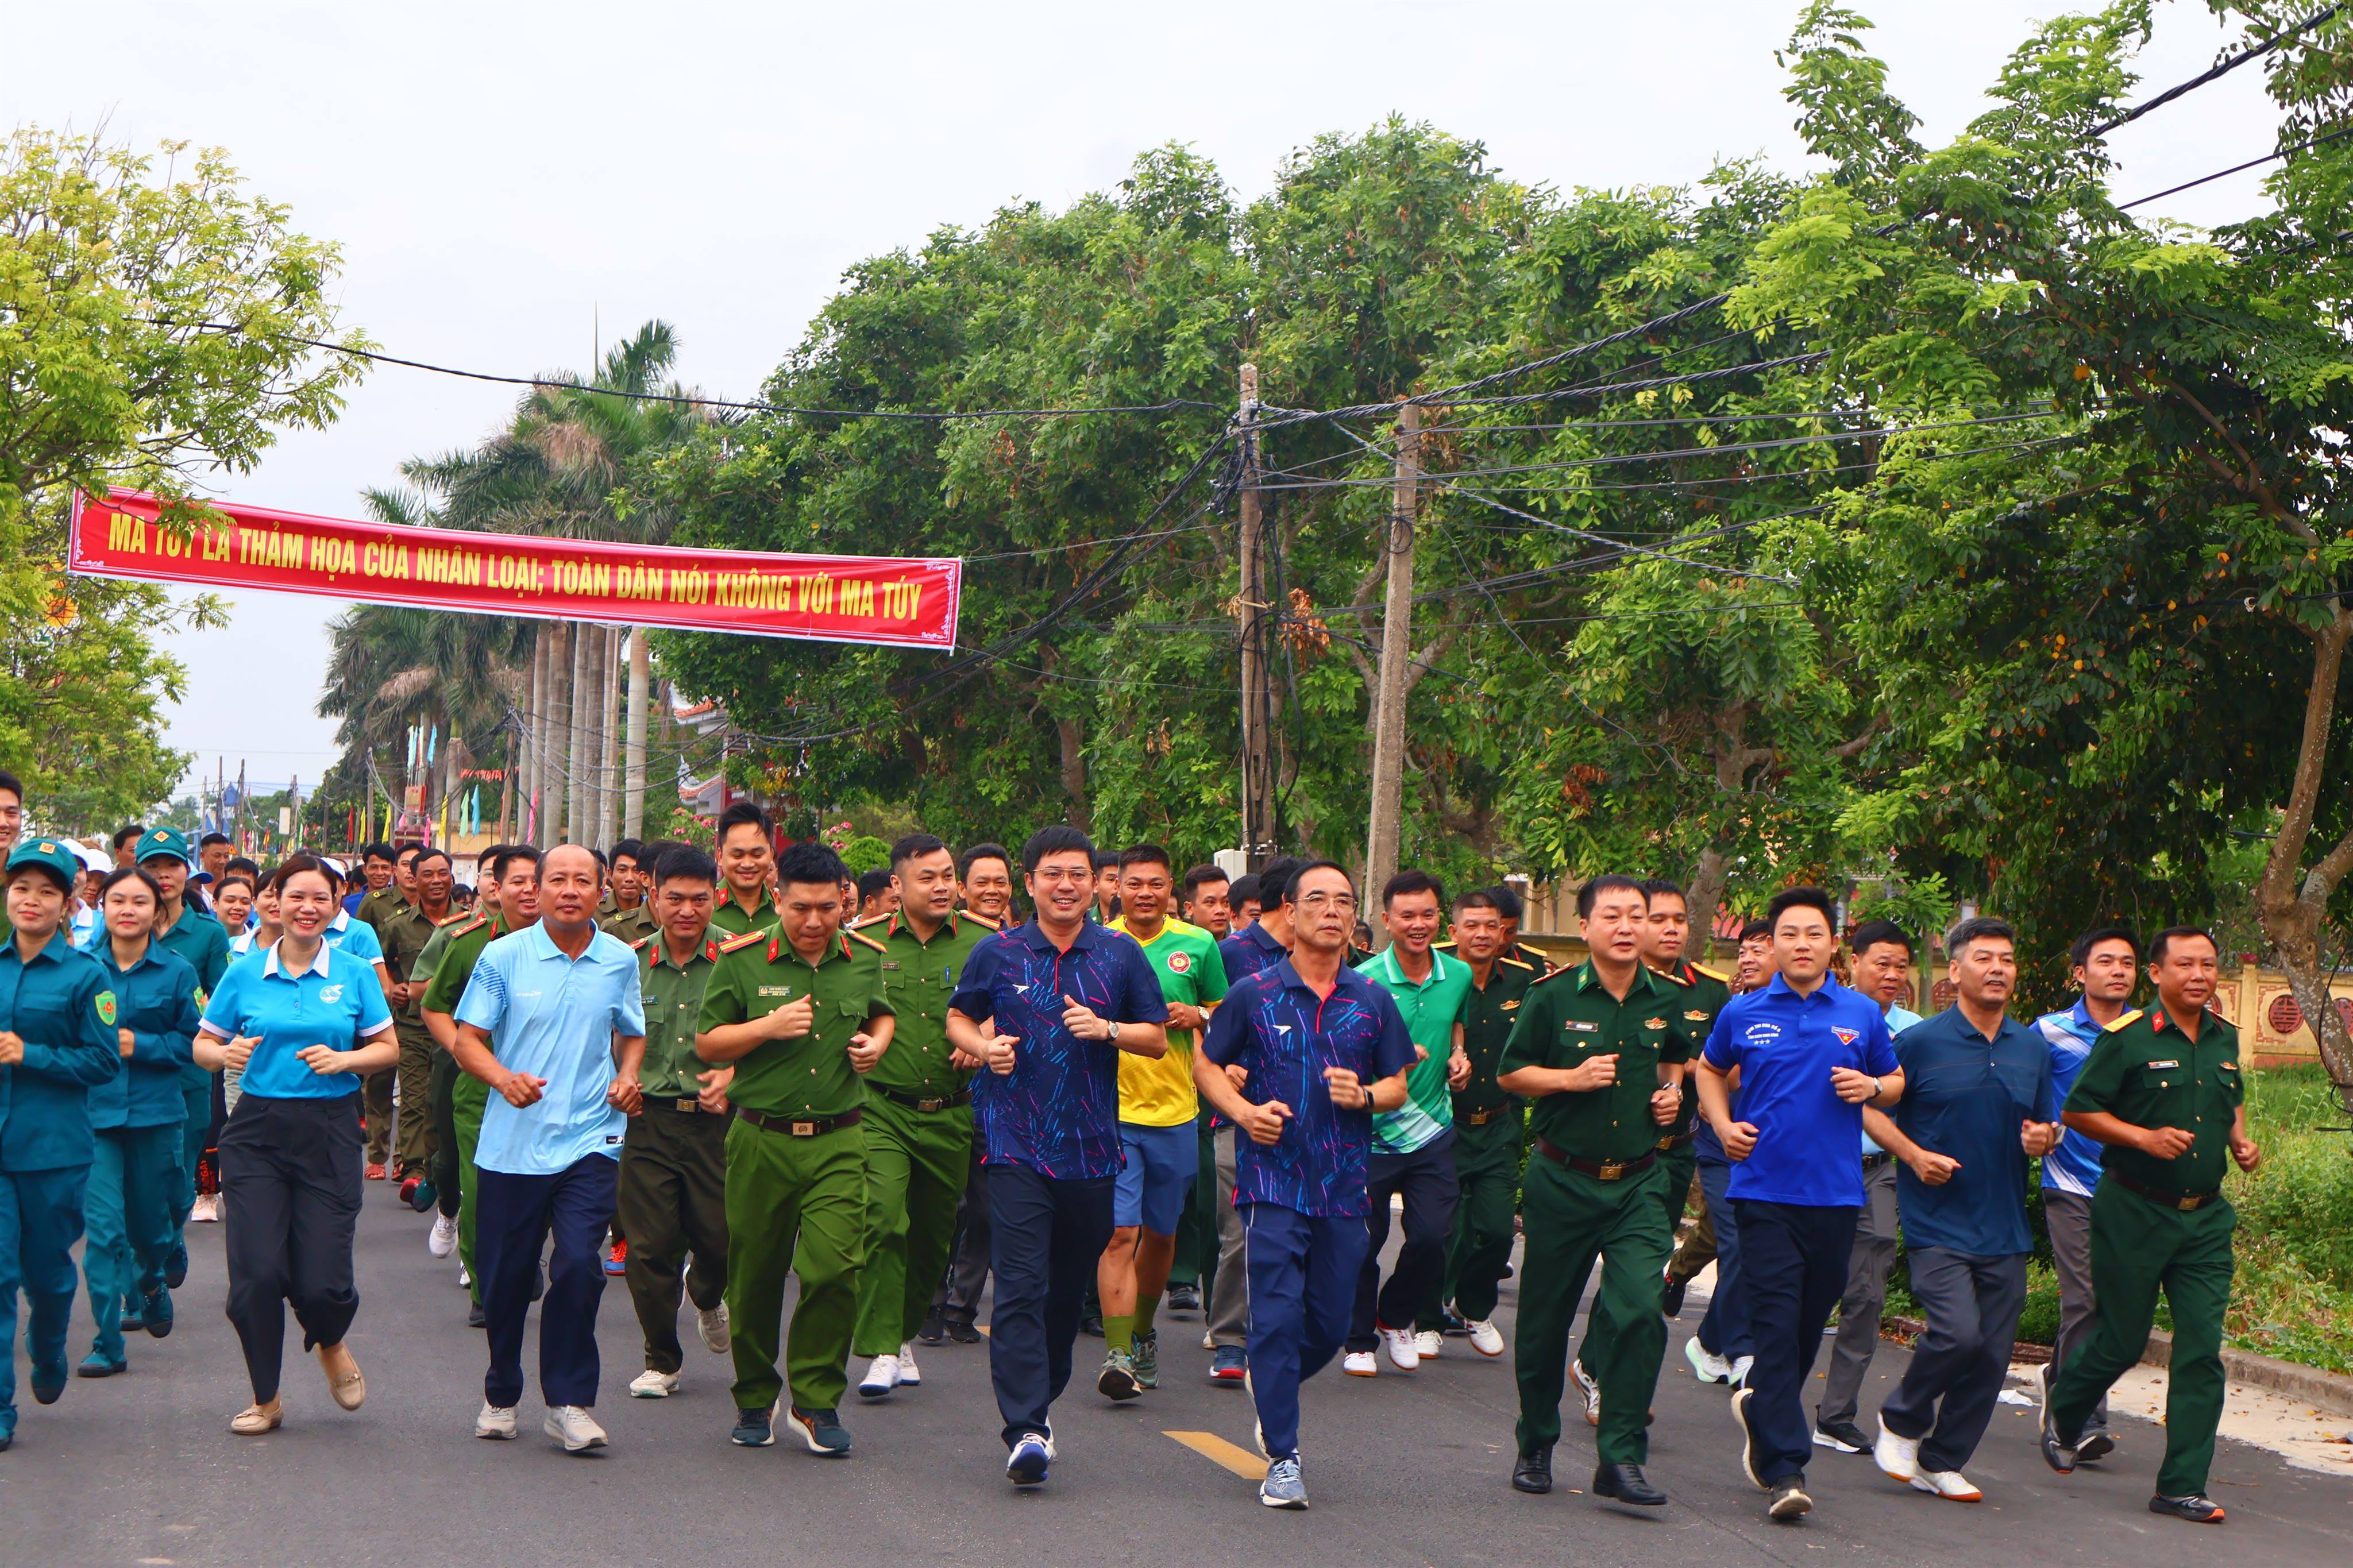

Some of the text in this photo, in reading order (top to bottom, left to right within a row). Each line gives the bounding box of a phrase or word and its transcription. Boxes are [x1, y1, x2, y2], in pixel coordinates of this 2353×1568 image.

[109, 512, 146, 554] MA
[239, 521, 304, 569] THẢM
[310, 536, 356, 581] HỌA
[364, 534, 409, 580] CỦA
[416, 544, 481, 586] NHÂN
[487, 554, 545, 598] LOẠI;
[551, 556, 611, 596] TOÀN
[616, 559, 664, 601] DÂN
[669, 564, 708, 605] NÓI
[715, 569, 792, 612] KHÔNG
[799, 571, 834, 614] VỚI
[839, 579, 874, 617] MA
[882, 574, 923, 620] TÚY
